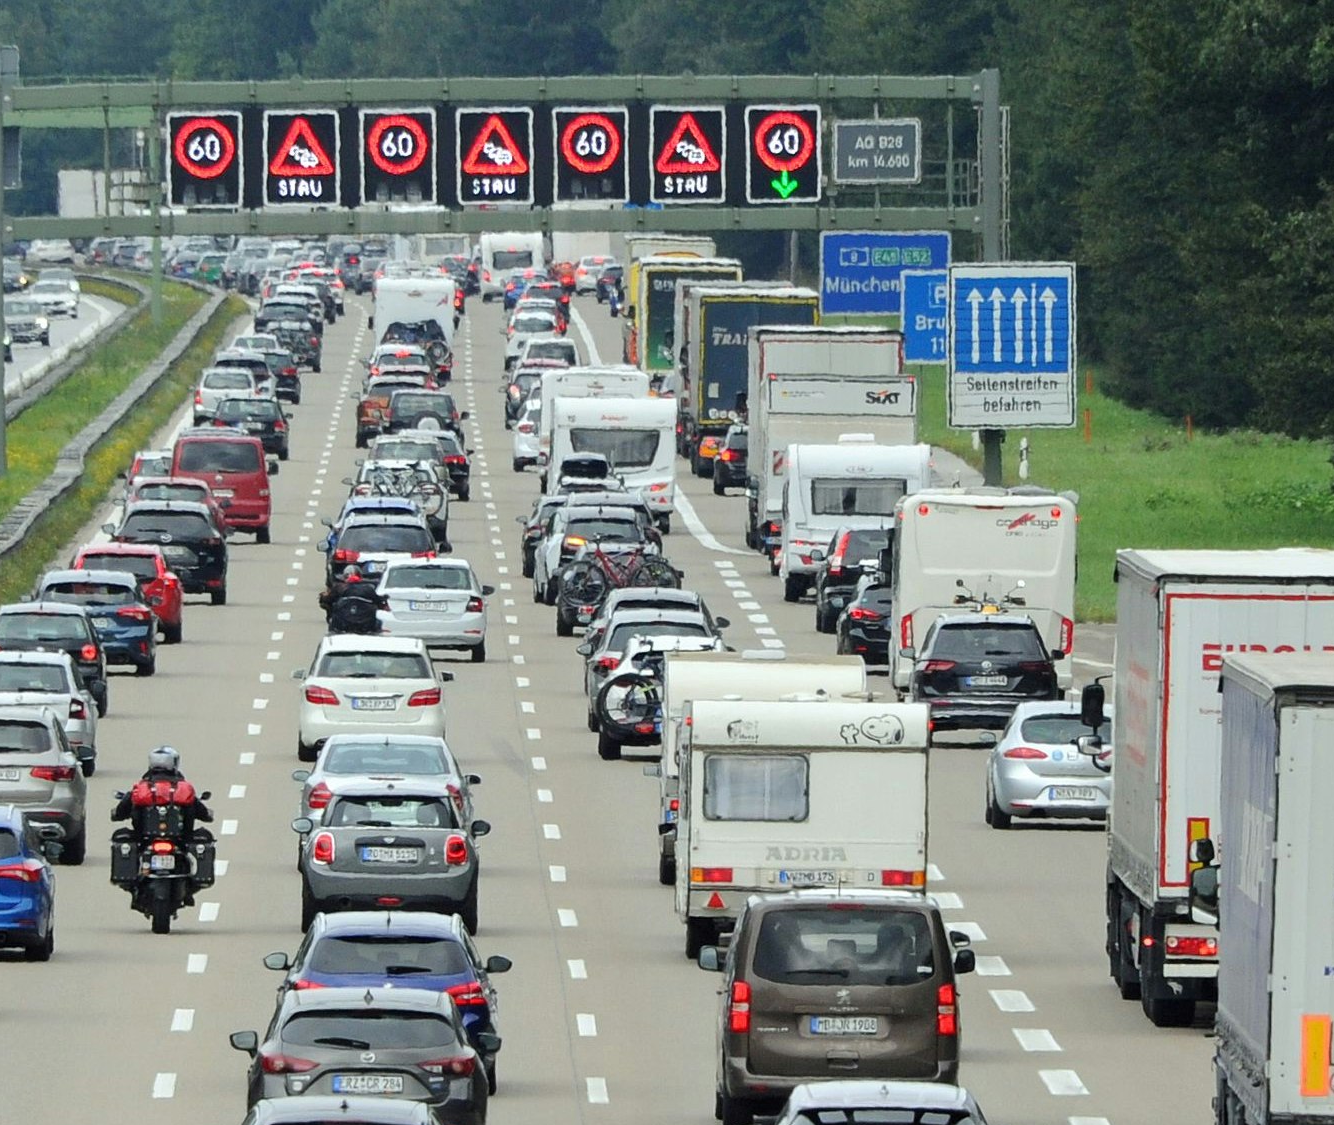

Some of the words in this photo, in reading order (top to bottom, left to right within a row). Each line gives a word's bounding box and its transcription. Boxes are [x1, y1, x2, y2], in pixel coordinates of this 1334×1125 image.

[188, 134, 220, 162] 60
[382, 132, 412, 158] 60
[575, 130, 606, 156] 60
[768, 128, 800, 155] 60
[848, 155, 868, 168] km
[278, 181, 323, 198] STAU
[472, 180, 516, 195] STAU
[664, 176, 708, 194] STAU
[825, 276, 902, 295] München
[966, 376, 1058, 392] Seitenstreifen
[983, 396, 1042, 413] befahren
[765, 847, 848, 861] ADRIA
